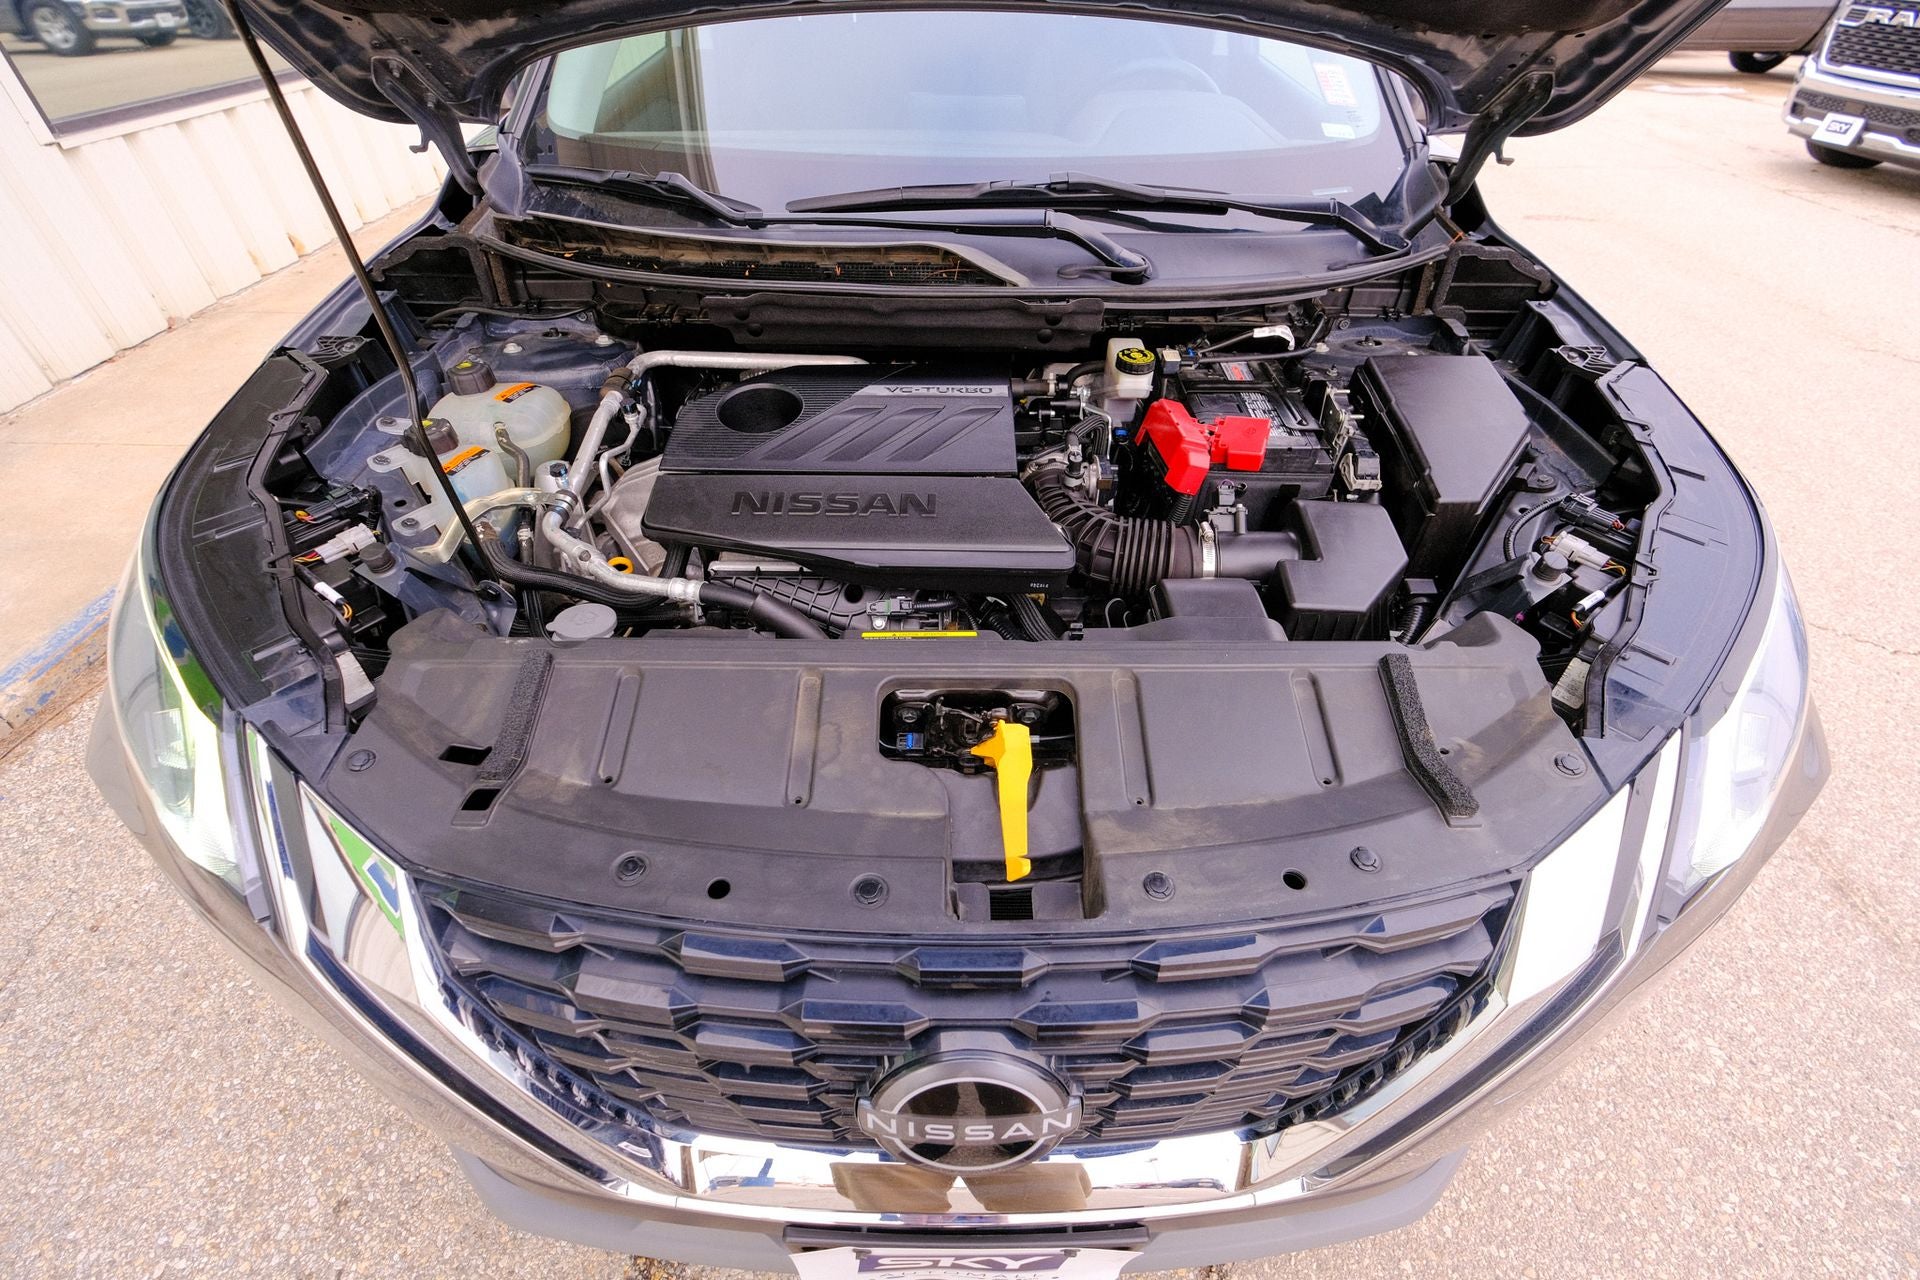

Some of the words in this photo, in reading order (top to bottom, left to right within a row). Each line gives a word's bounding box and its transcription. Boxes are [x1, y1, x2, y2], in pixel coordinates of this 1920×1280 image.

[1864, 8, 1920, 28] RA
[884, 386, 993, 394] VC-TURBO
[731, 491, 937, 517] NISSAN
[866, 1112, 1072, 1142] NISSAN
[873, 1255, 1054, 1270] SKY
